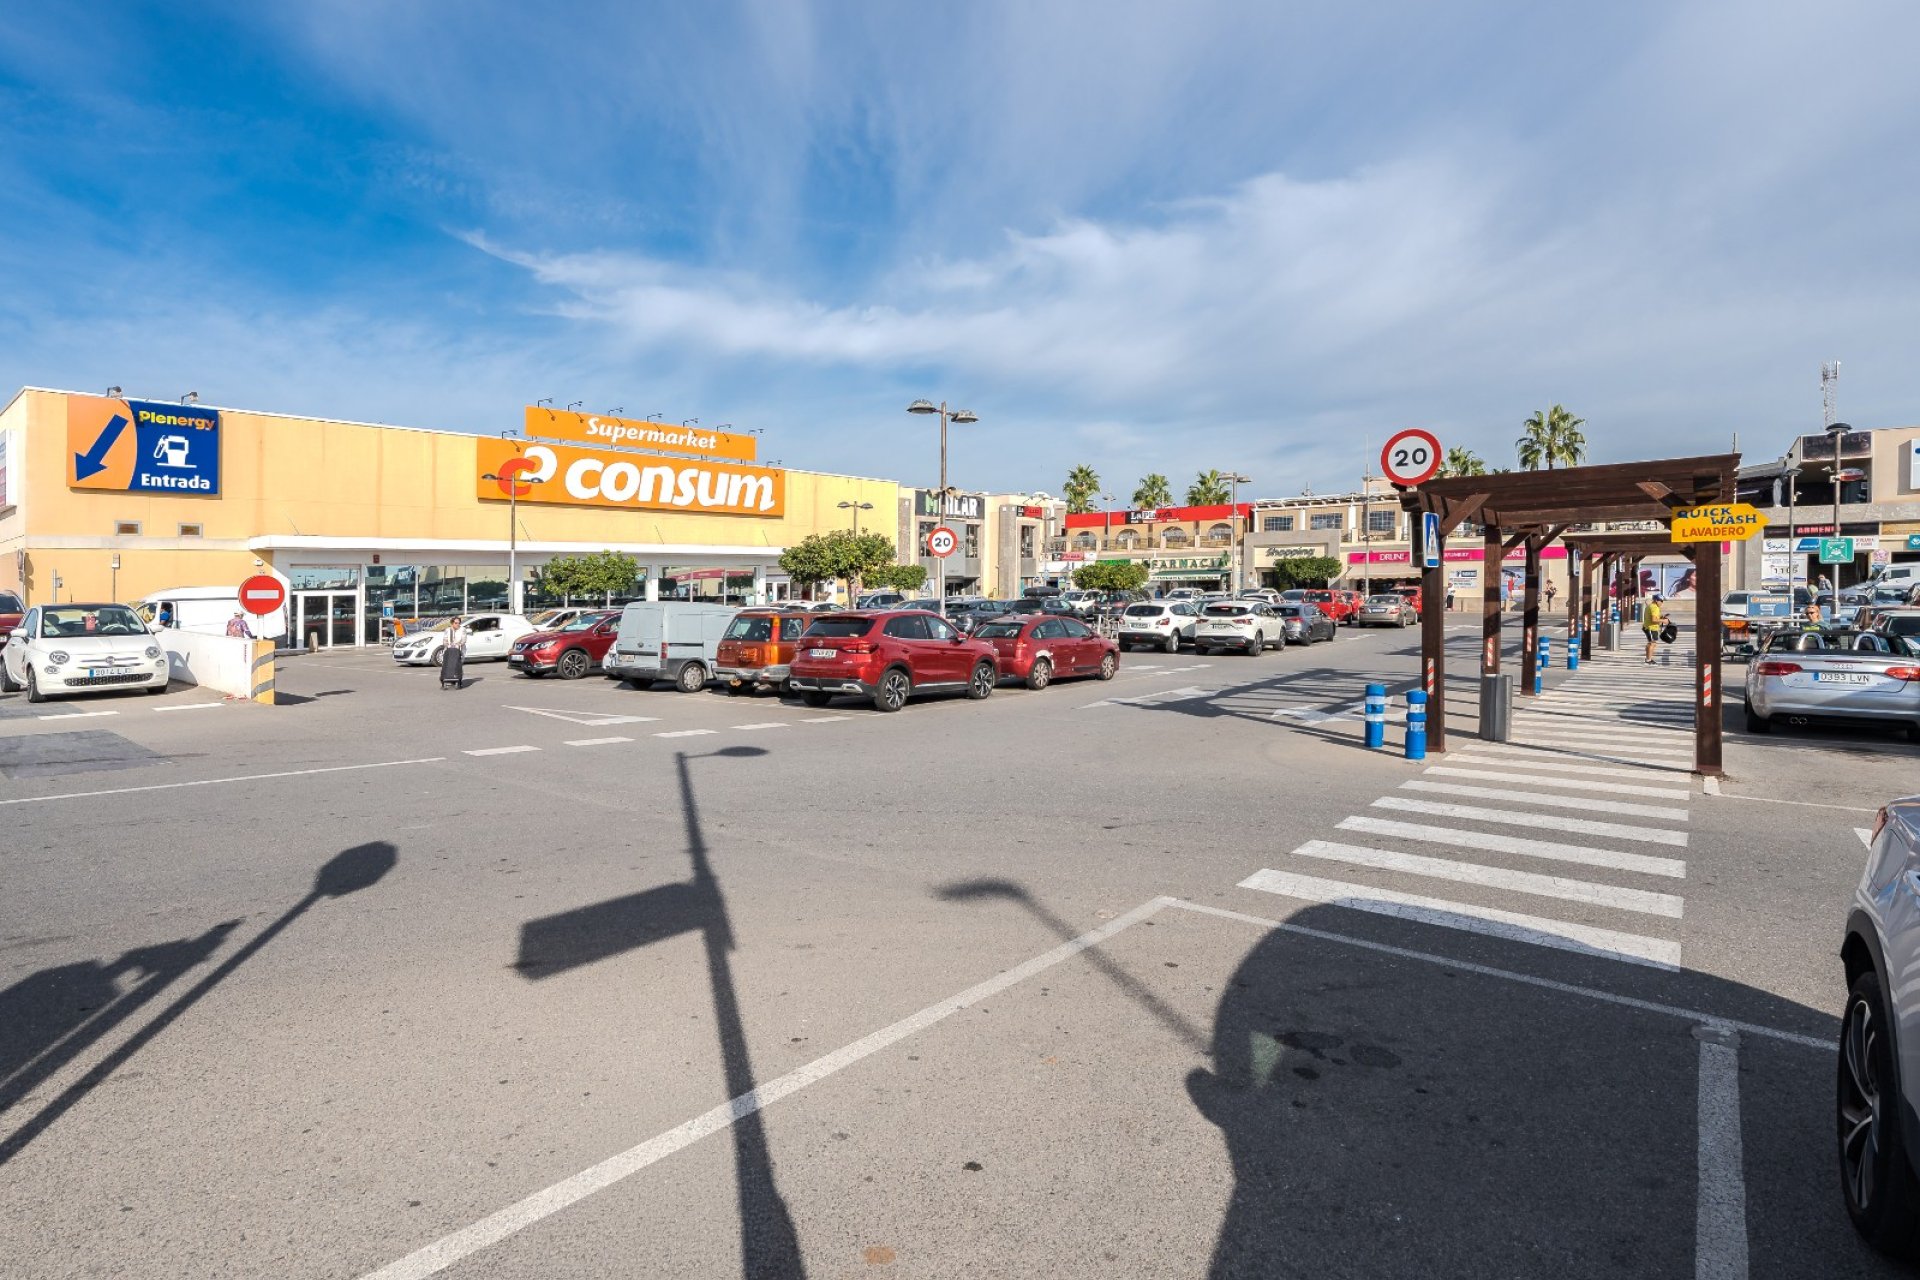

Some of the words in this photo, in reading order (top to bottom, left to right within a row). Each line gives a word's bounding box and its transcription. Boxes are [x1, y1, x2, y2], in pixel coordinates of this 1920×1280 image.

[138, 411, 216, 431] Plenergy
[586, 416, 717, 450] Supermarket
[1394, 447, 1427, 467] 20
[141, 473, 210, 490] Entrada
[564, 458, 775, 511] consum
[1677, 507, 1731, 519] QUICK
[1711, 513, 1757, 525] WASH
[1681, 526, 1746, 538] LAVADERO
[934, 537, 951, 548] 20
[1151, 558, 1224, 570] FARMACIA
[1850, 673, 1870, 682] LVN
